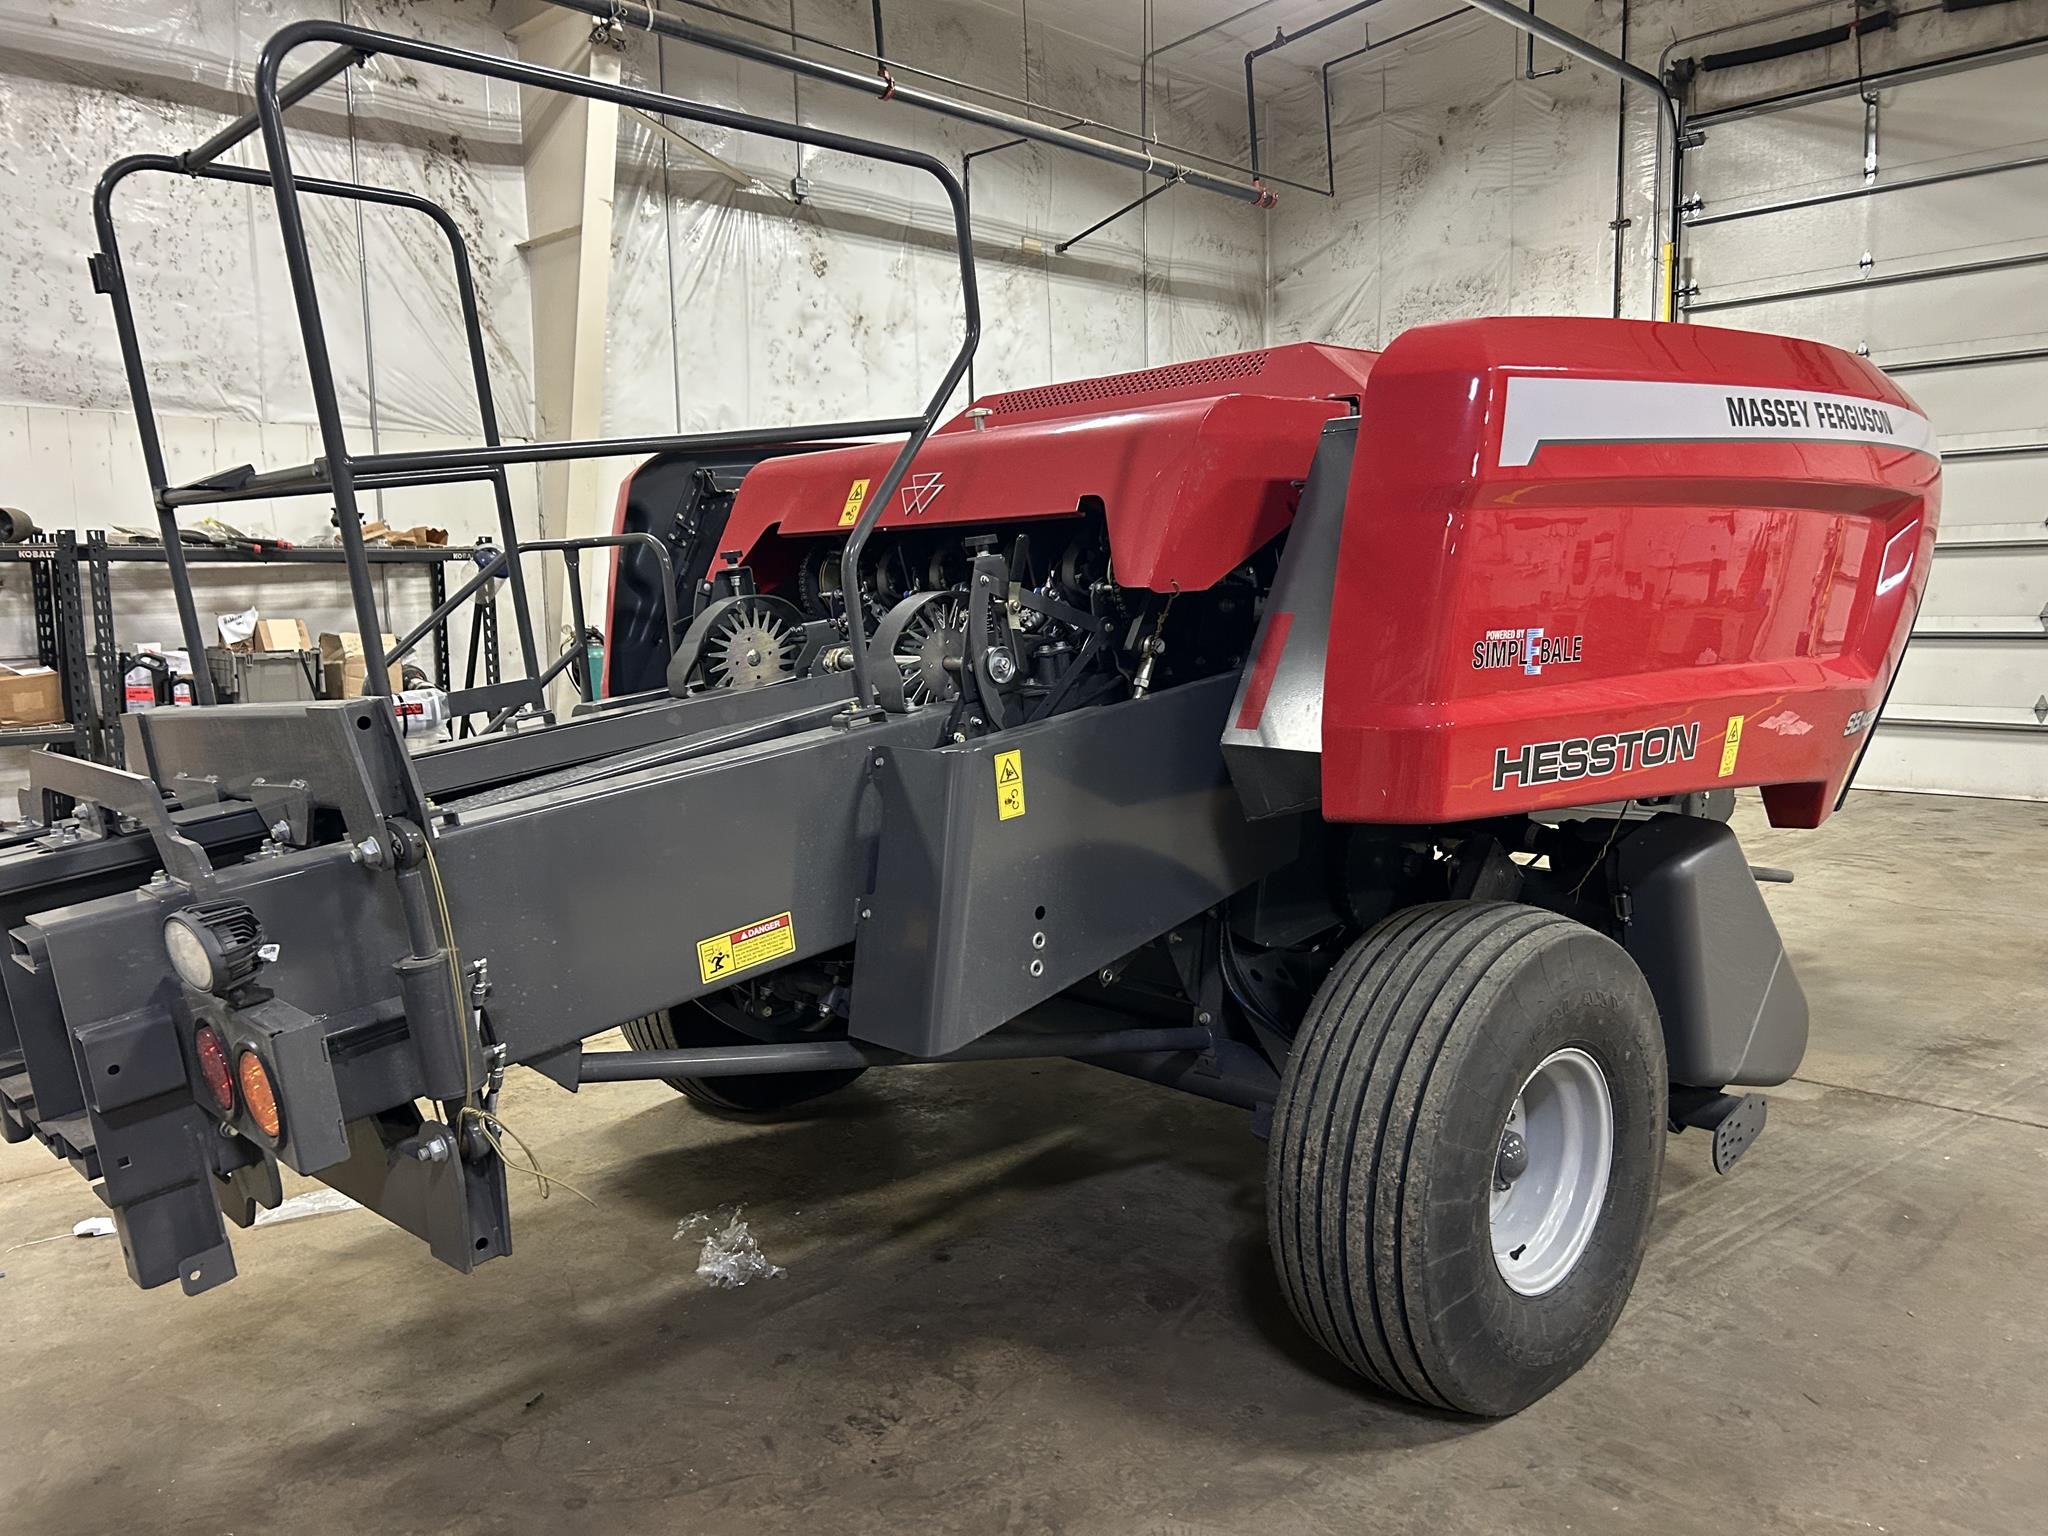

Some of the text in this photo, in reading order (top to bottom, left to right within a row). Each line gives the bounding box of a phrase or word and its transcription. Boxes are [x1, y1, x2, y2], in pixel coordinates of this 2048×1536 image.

[1726, 397, 1894, 435] MASSEY FERGUSON
[18, 550, 56, 559] KOBALT
[452, 552, 473, 560] KOBA
[1486, 629, 1525, 641] POWERED BY
[1492, 722, 1700, 791] HESSTON
[748, 920, 781, 937] DANGER
